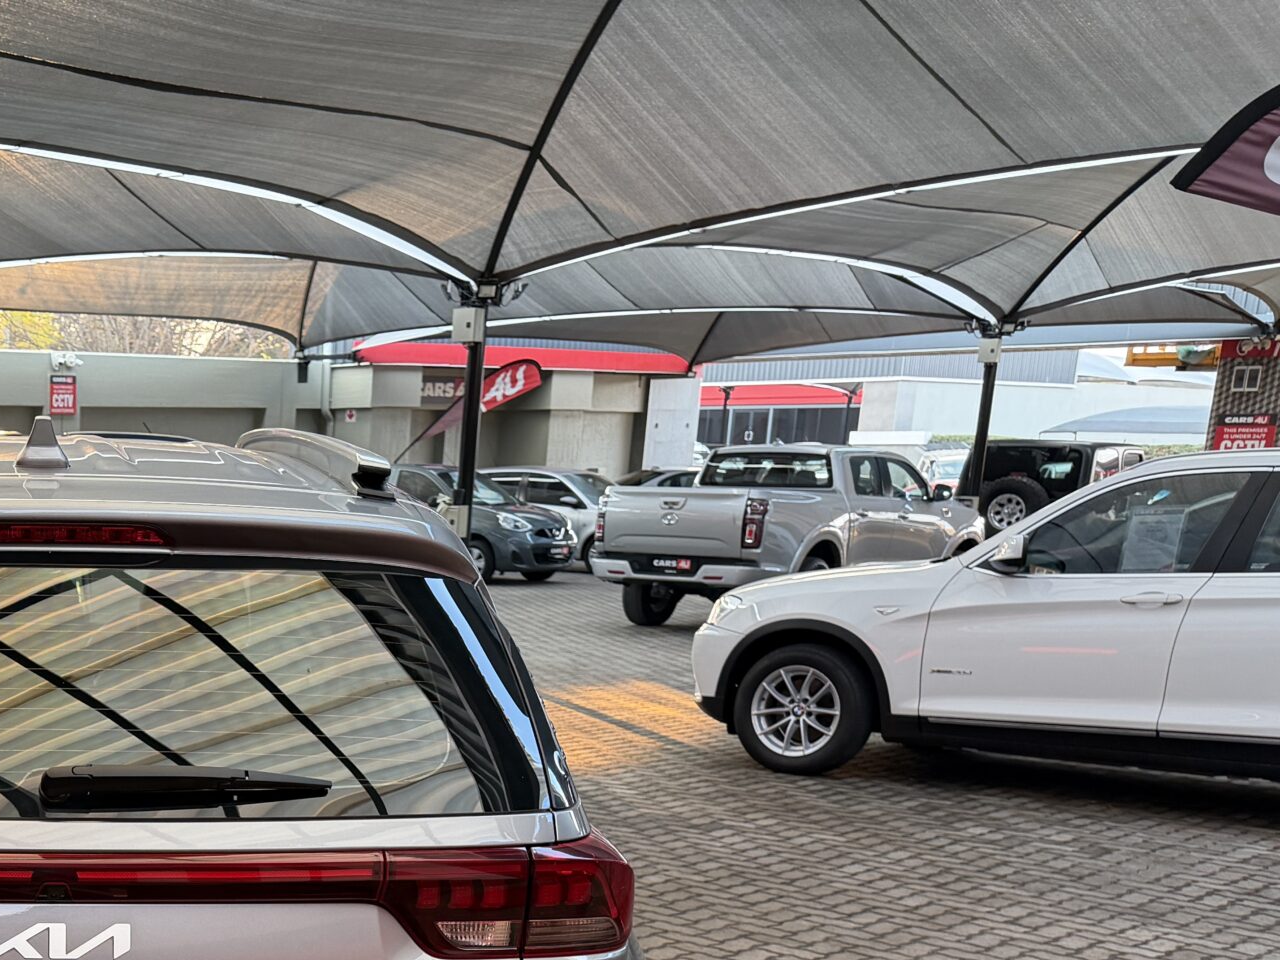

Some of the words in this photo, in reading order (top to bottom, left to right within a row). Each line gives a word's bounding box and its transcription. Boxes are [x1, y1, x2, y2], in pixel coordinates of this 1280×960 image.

[421, 382, 454, 397] ARS
[481, 364, 527, 402] 4U
[52, 394, 74, 407] CCTV
[1224, 416, 1254, 424] CARS
[1254, 415, 1268, 425] 4U
[652, 559, 677, 568] CARS
